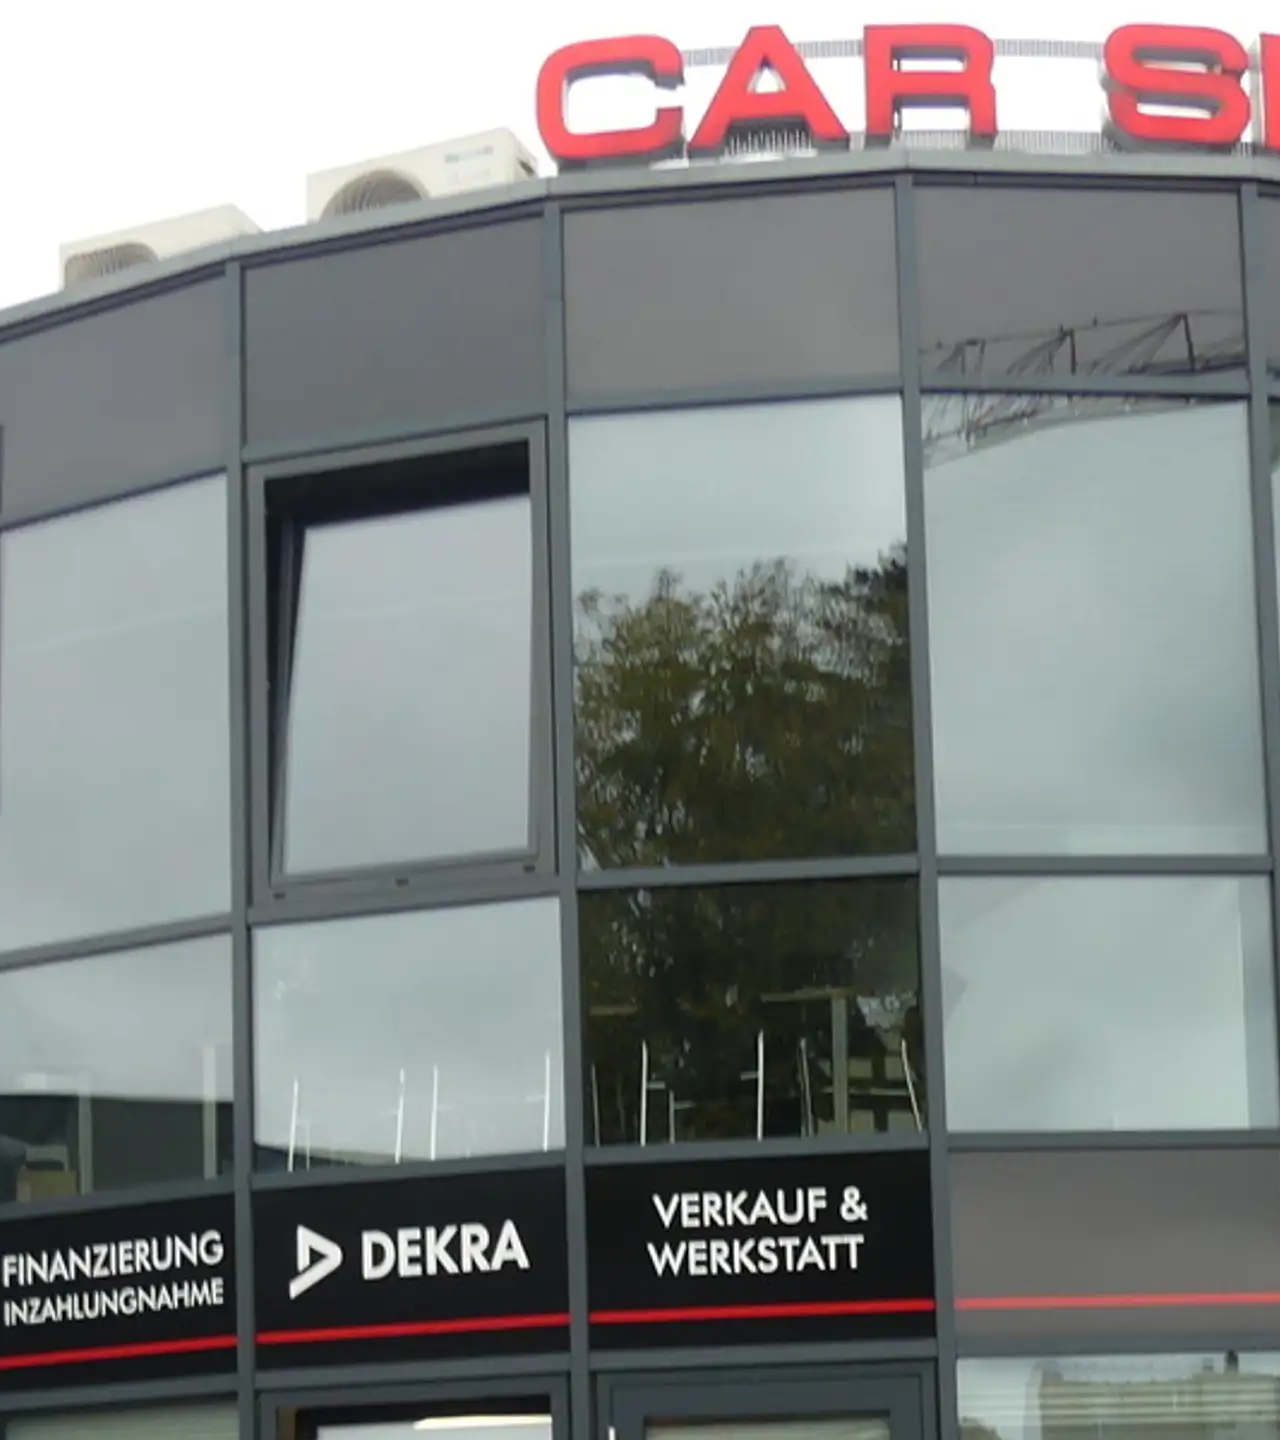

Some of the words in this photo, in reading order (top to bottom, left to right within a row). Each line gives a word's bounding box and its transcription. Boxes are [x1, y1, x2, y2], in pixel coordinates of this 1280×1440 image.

[536, 24, 995, 160] CAR
[653, 1187, 826, 1229] VERKAUF
[840, 1186, 868, 1222] &
[2, 1229, 224, 1288] FINANZIERUNG
[361, 1219, 530, 1280] DEKRA
[647, 1234, 864, 1277] WERKSTATT
[4, 1277, 224, 1326] INZAHLUNGNAHME
